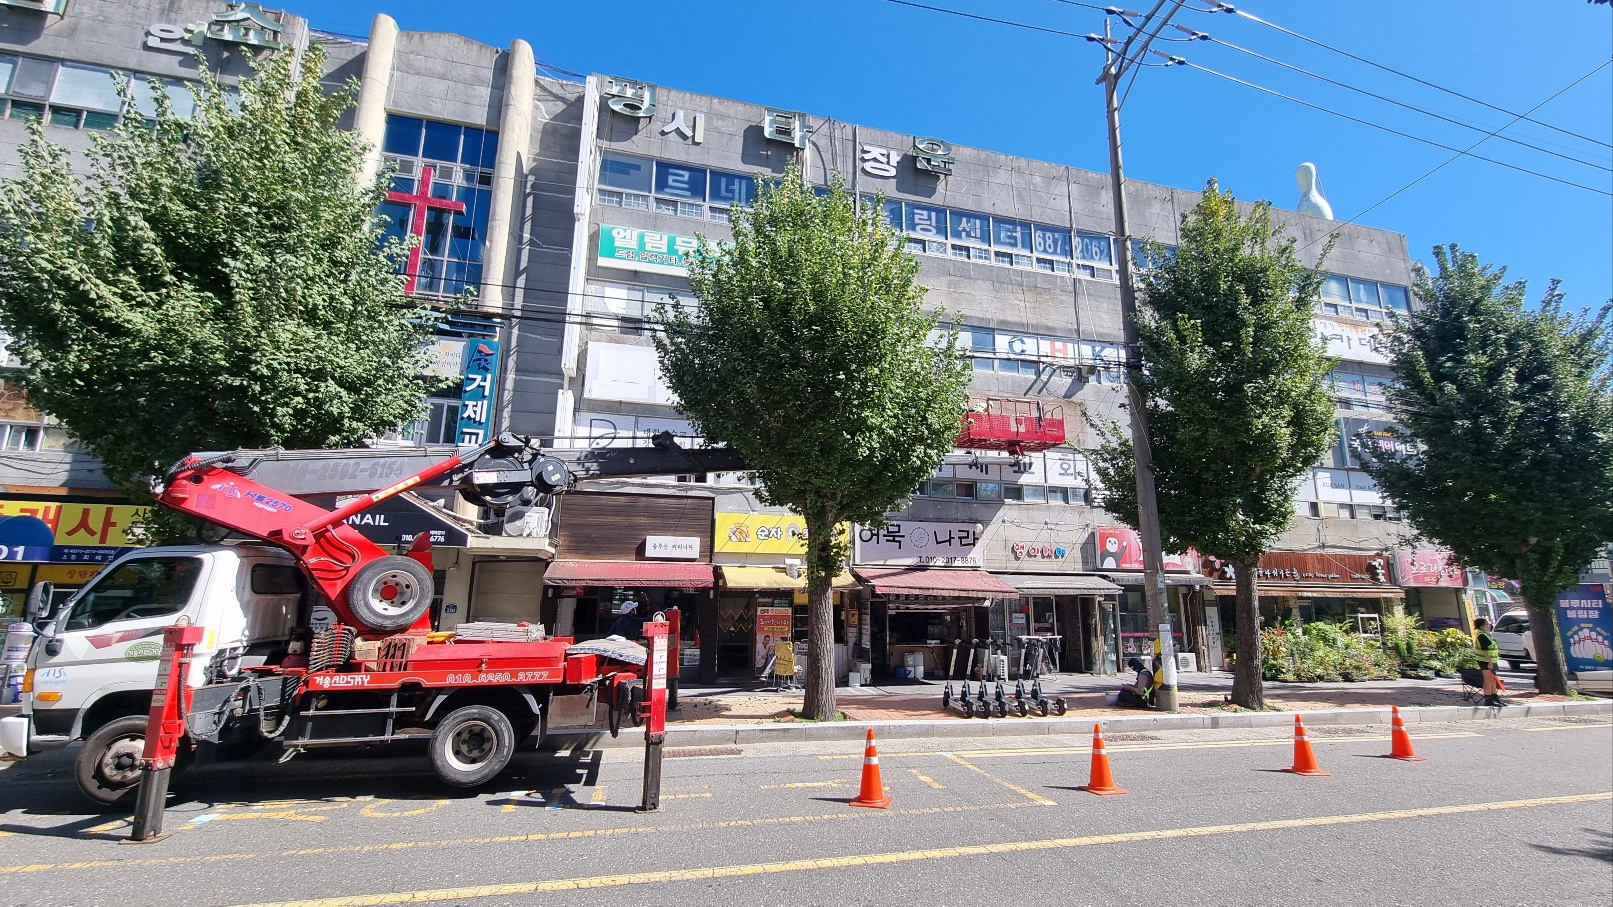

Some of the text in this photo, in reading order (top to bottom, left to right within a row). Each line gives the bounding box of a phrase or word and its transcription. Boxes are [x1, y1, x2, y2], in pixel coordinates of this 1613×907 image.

[343, 513, 390, 527] NAIL
[858, 523, 906, 550] 어묵
[932, 528, 982, 548] 나라
